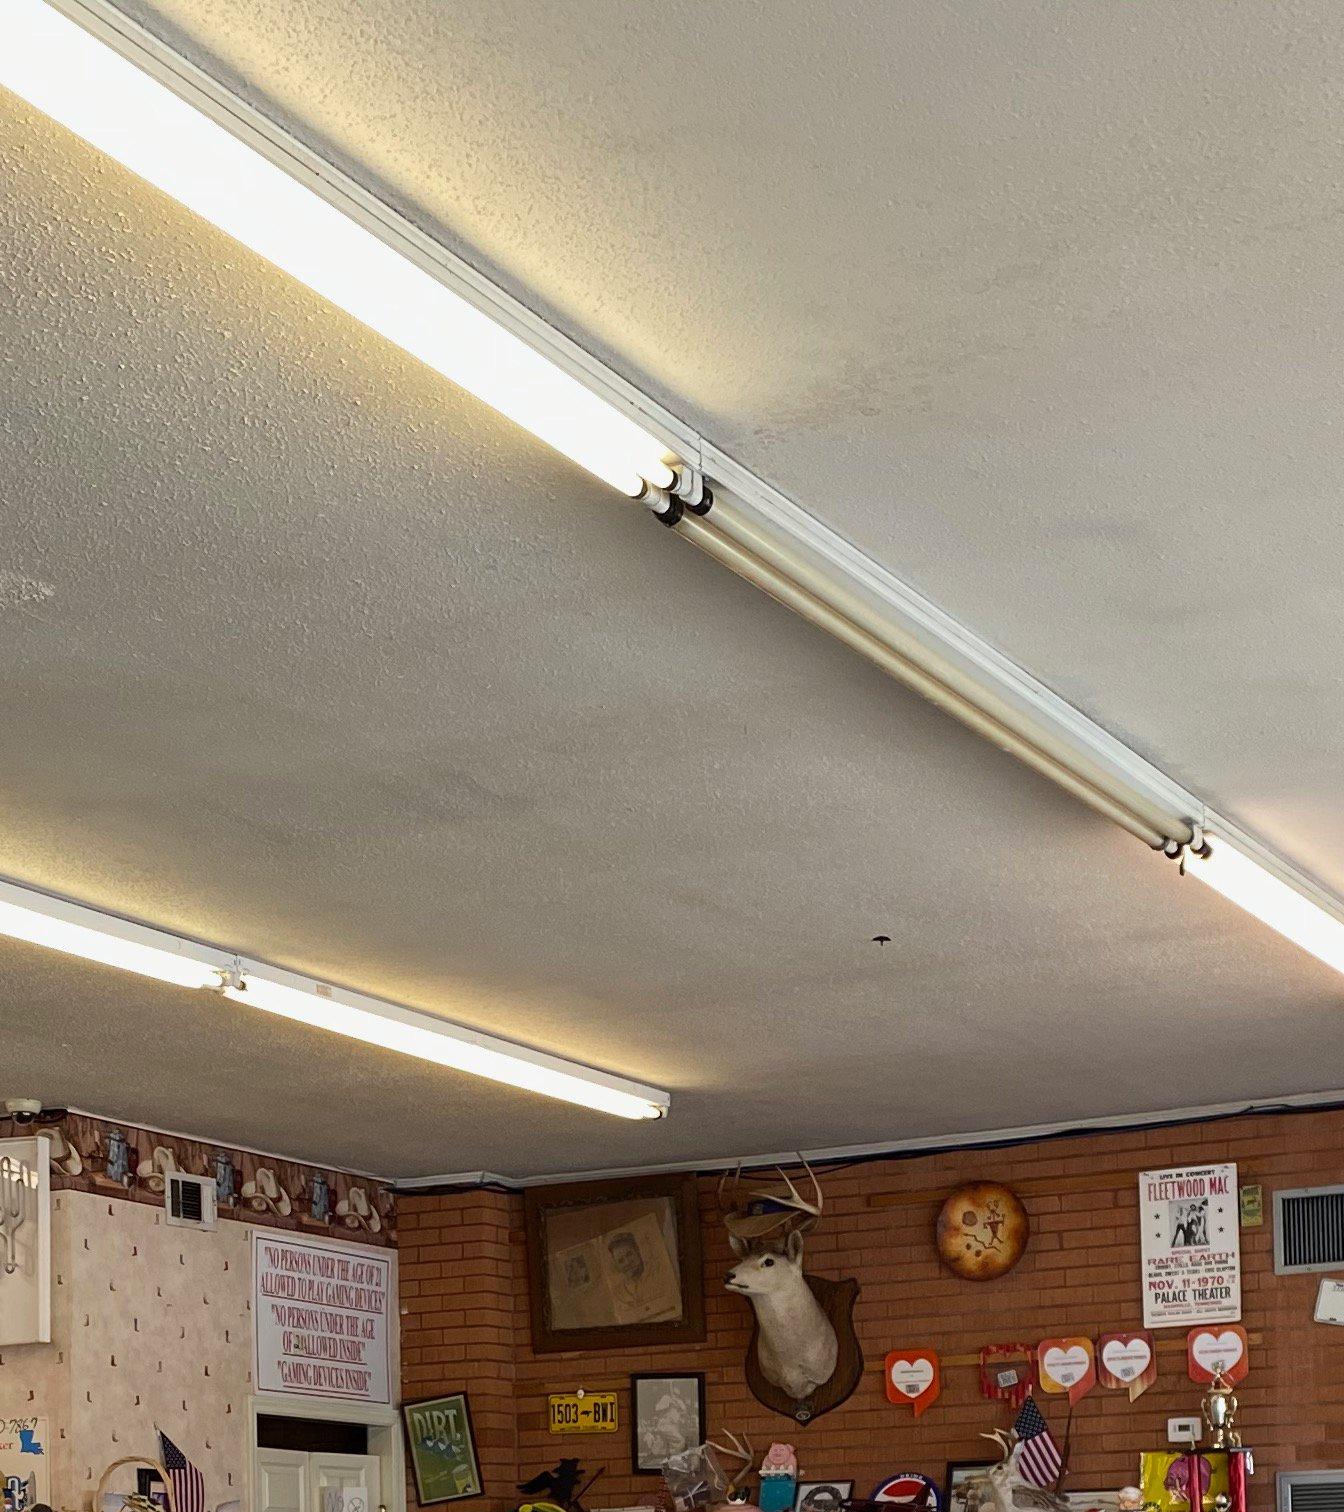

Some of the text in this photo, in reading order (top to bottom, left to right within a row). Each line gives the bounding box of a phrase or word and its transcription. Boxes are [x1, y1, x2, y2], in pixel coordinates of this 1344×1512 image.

[1186, 1169, 1216, 1178] CONCERT
[1148, 1176, 1230, 1202] FLEETWOOD MAC
[280, 1249, 312, 1273] PERSONS
[312, 1253, 336, 1277] UNDER
[336, 1258, 350, 1282] THE
[352, 1262, 365, 1284] AGE
[366, 1264, 376, 1286] OF
[261, 1272, 296, 1296] ALLOWED
[297, 1277, 306, 1299] TO
[308, 1279, 326, 1302] PLAY
[326, 1281, 354, 1308] GAMING
[1148, 1280, 1179, 1291] NOV.
[1182, 1275, 1224, 1288] 11-1970
[1154, 1286, 1232, 1304] PALACE THEATER
[287, 1306, 319, 1331] PERSONS
[320, 1310, 344, 1335] UNDER
[346, 1315, 359, 1337] THE
[361, 1318, 376, 1340] AGE
[283, 1331, 292, 1352] OF
[304, 1335, 339, 1359] ALLOWED
[313, 1364, 345, 1389] DEVICES
[551, 1404, 579, 1425] 1503
